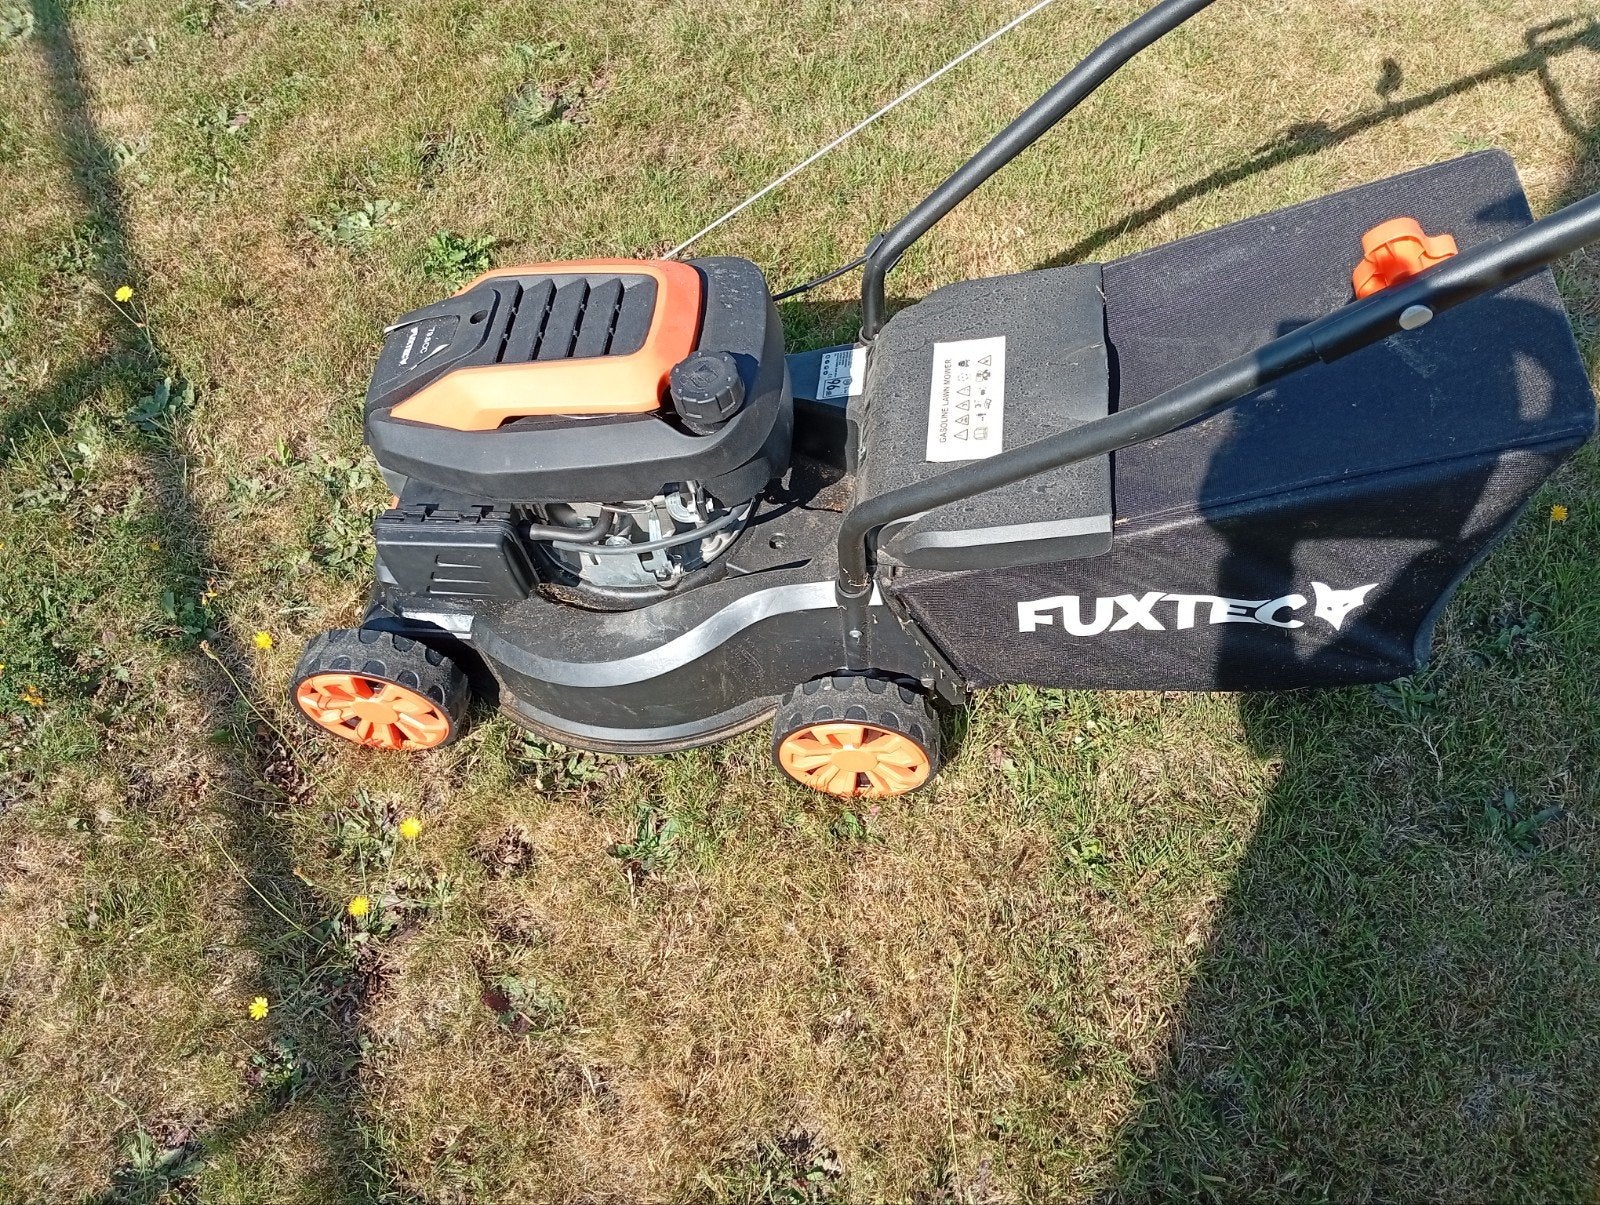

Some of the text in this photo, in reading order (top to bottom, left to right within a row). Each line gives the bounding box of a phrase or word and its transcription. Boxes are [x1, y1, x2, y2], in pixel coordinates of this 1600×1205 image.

[826, 379, 841, 390] 96
[944, 360, 952, 385] MOWER
[940, 408, 949, 443] GASOLINE
[1017, 592, 1307, 636] FUXTEC
